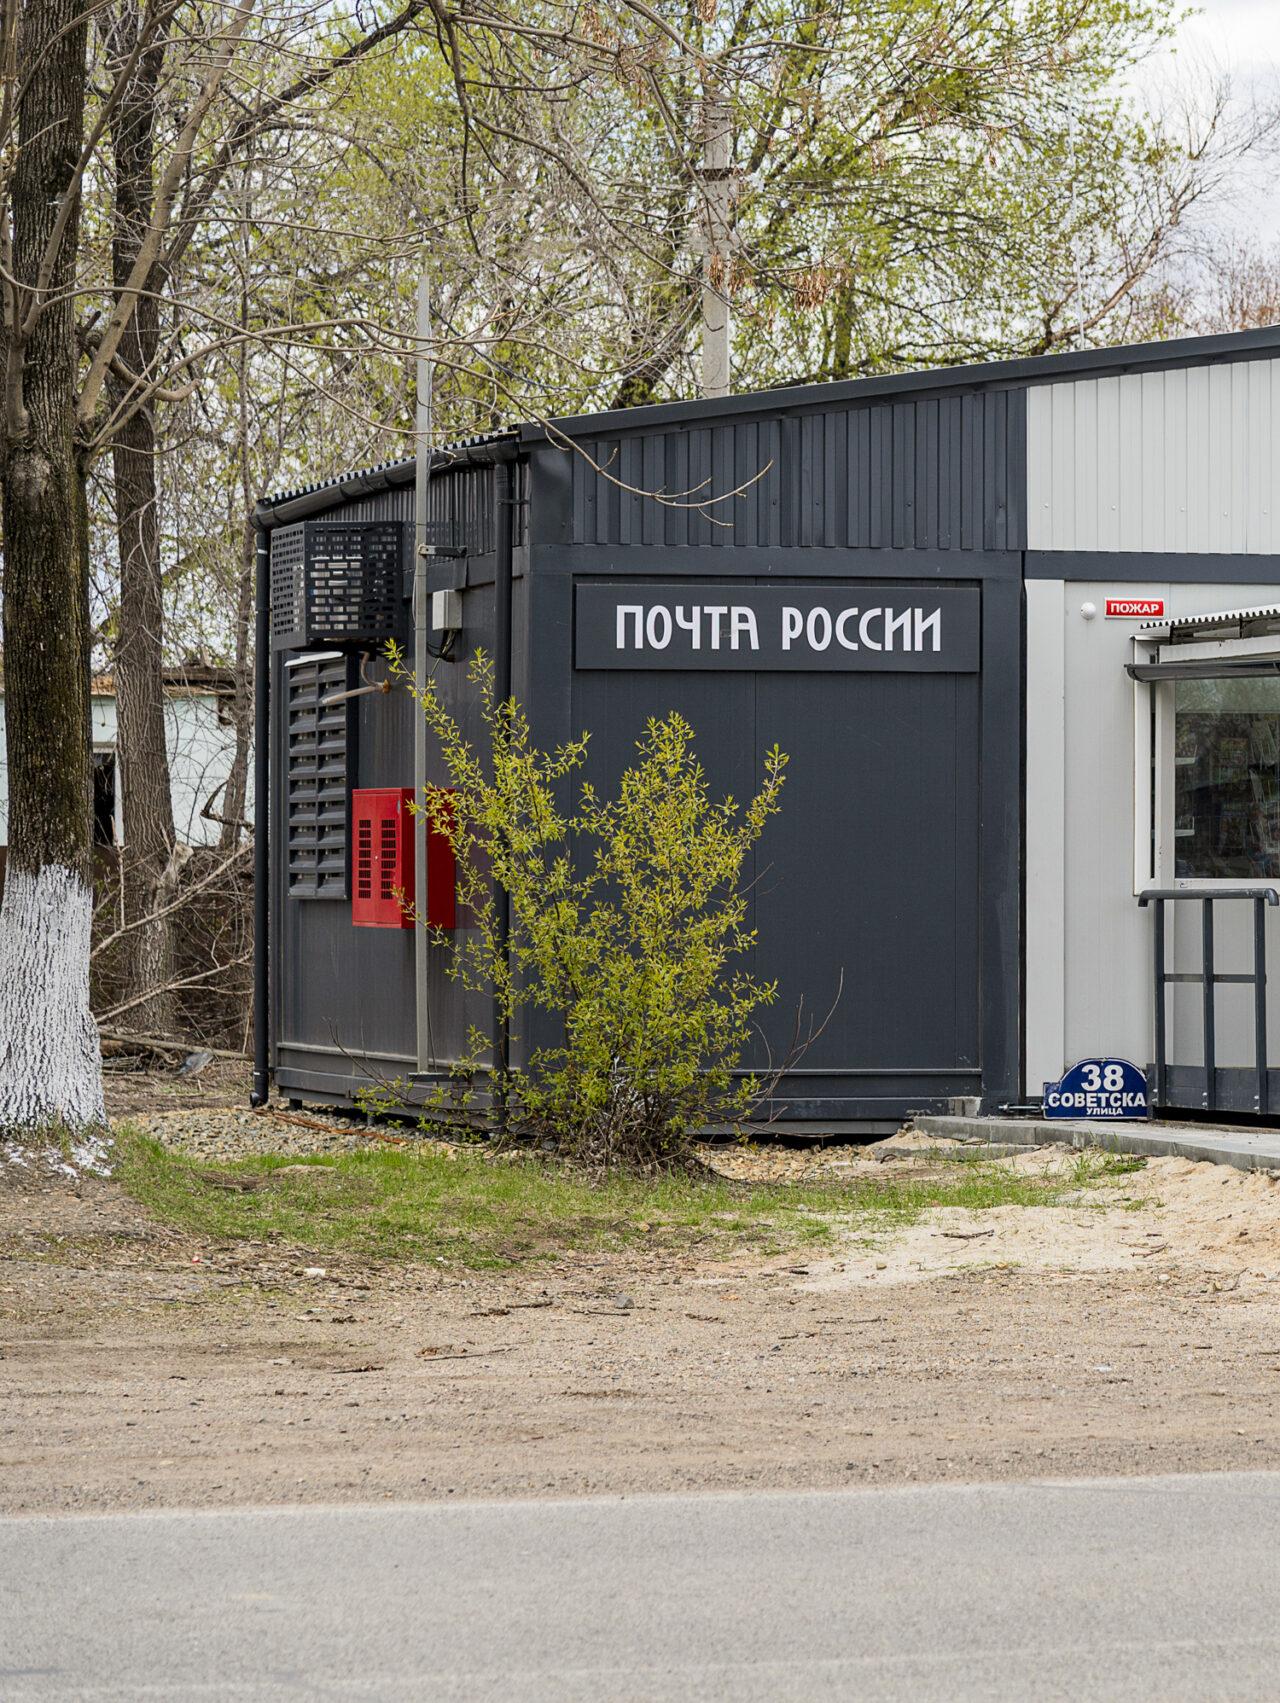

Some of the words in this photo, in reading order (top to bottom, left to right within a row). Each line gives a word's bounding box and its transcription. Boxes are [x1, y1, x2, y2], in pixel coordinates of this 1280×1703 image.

[1110, 603, 1160, 614] ПОЖАР
[616, 604, 760, 650] ПОЧТА
[781, 606, 942, 652] РОССИИ
[1080, 1064, 1124, 1092] 38
[1047, 1092, 1148, 1107] СОВЕТСКА
[1086, 1107, 1124, 1116] УЛИЦА
